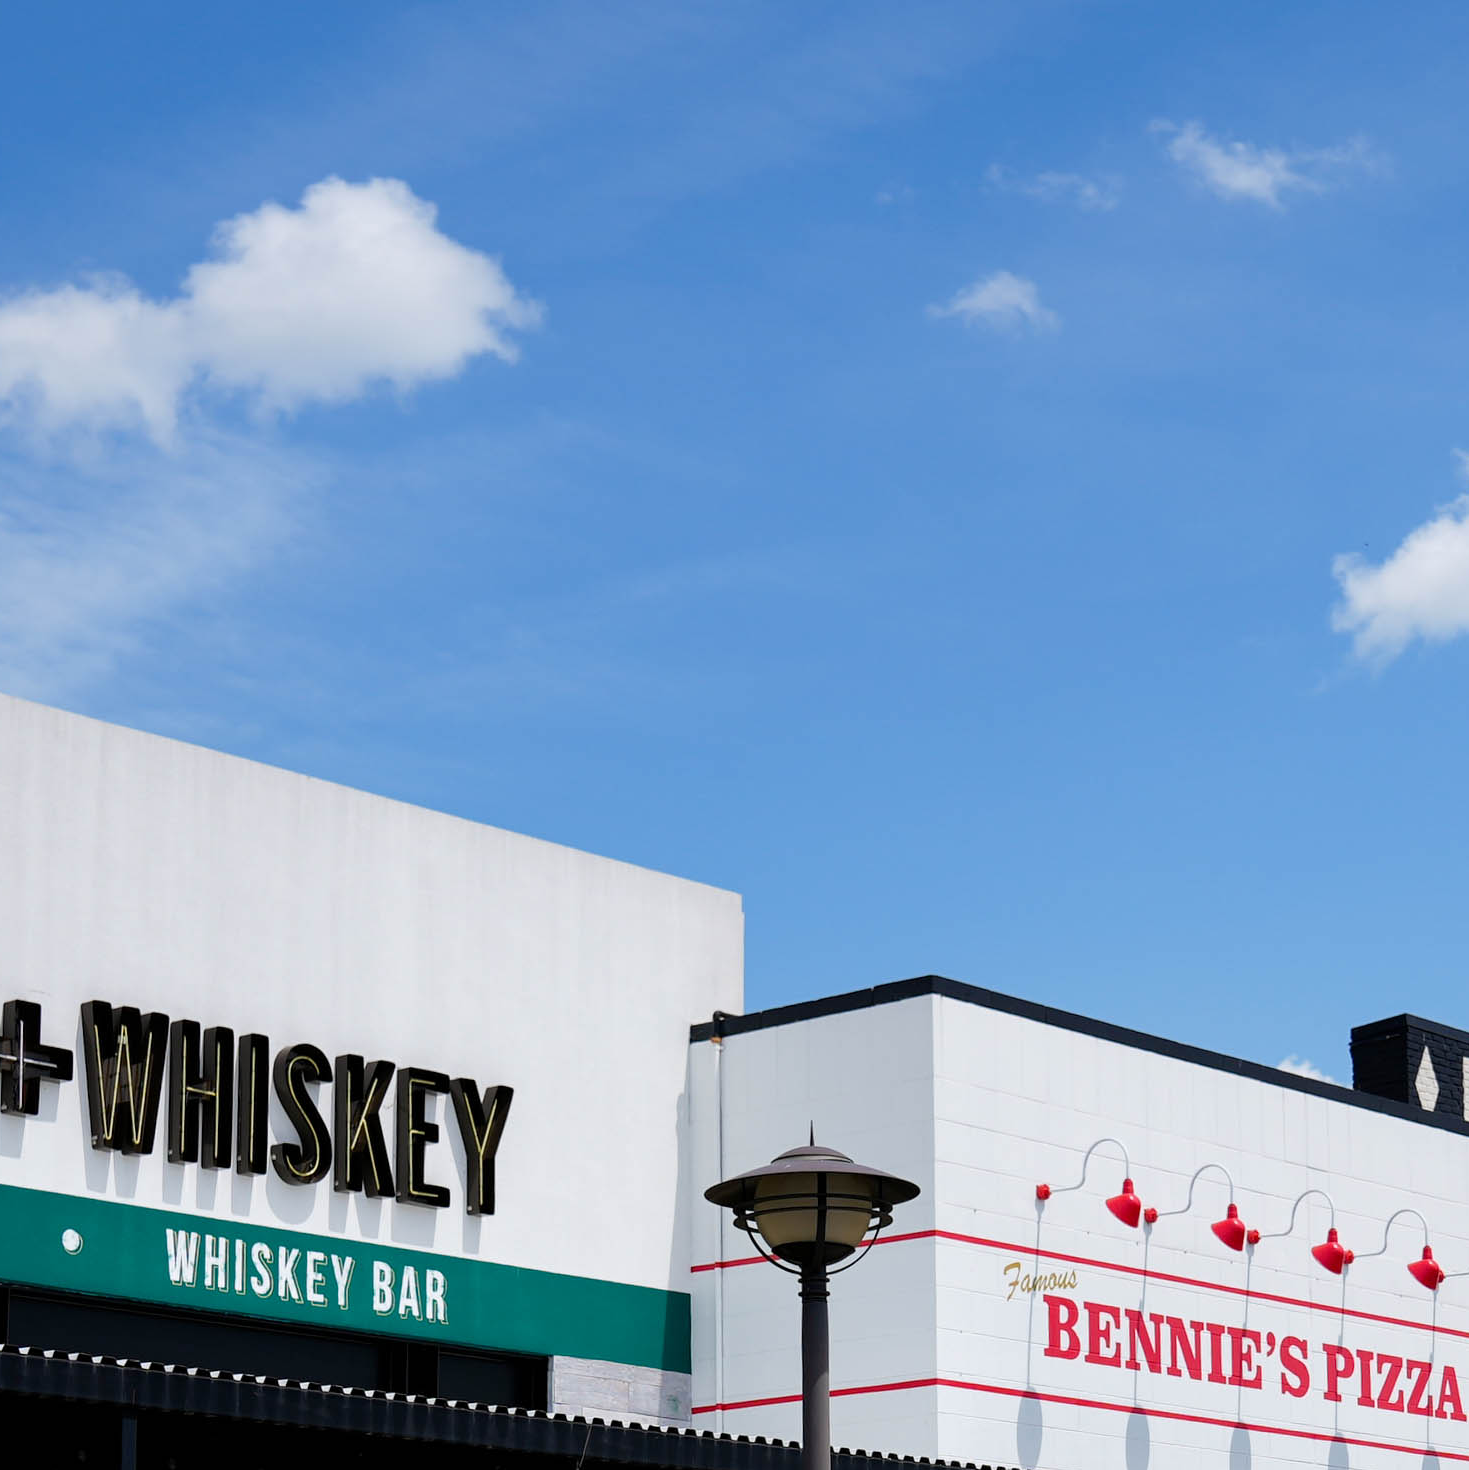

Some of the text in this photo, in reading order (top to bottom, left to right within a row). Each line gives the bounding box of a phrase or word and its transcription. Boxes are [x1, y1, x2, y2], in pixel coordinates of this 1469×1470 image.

[165, 1228, 355, 1310] WHISKEY
[372, 1260, 449, 1325] BAR
[1002, 1261, 1079, 1302] Famous
[1043, 1294, 1468, 1422] BENNIE'S PIZZA
